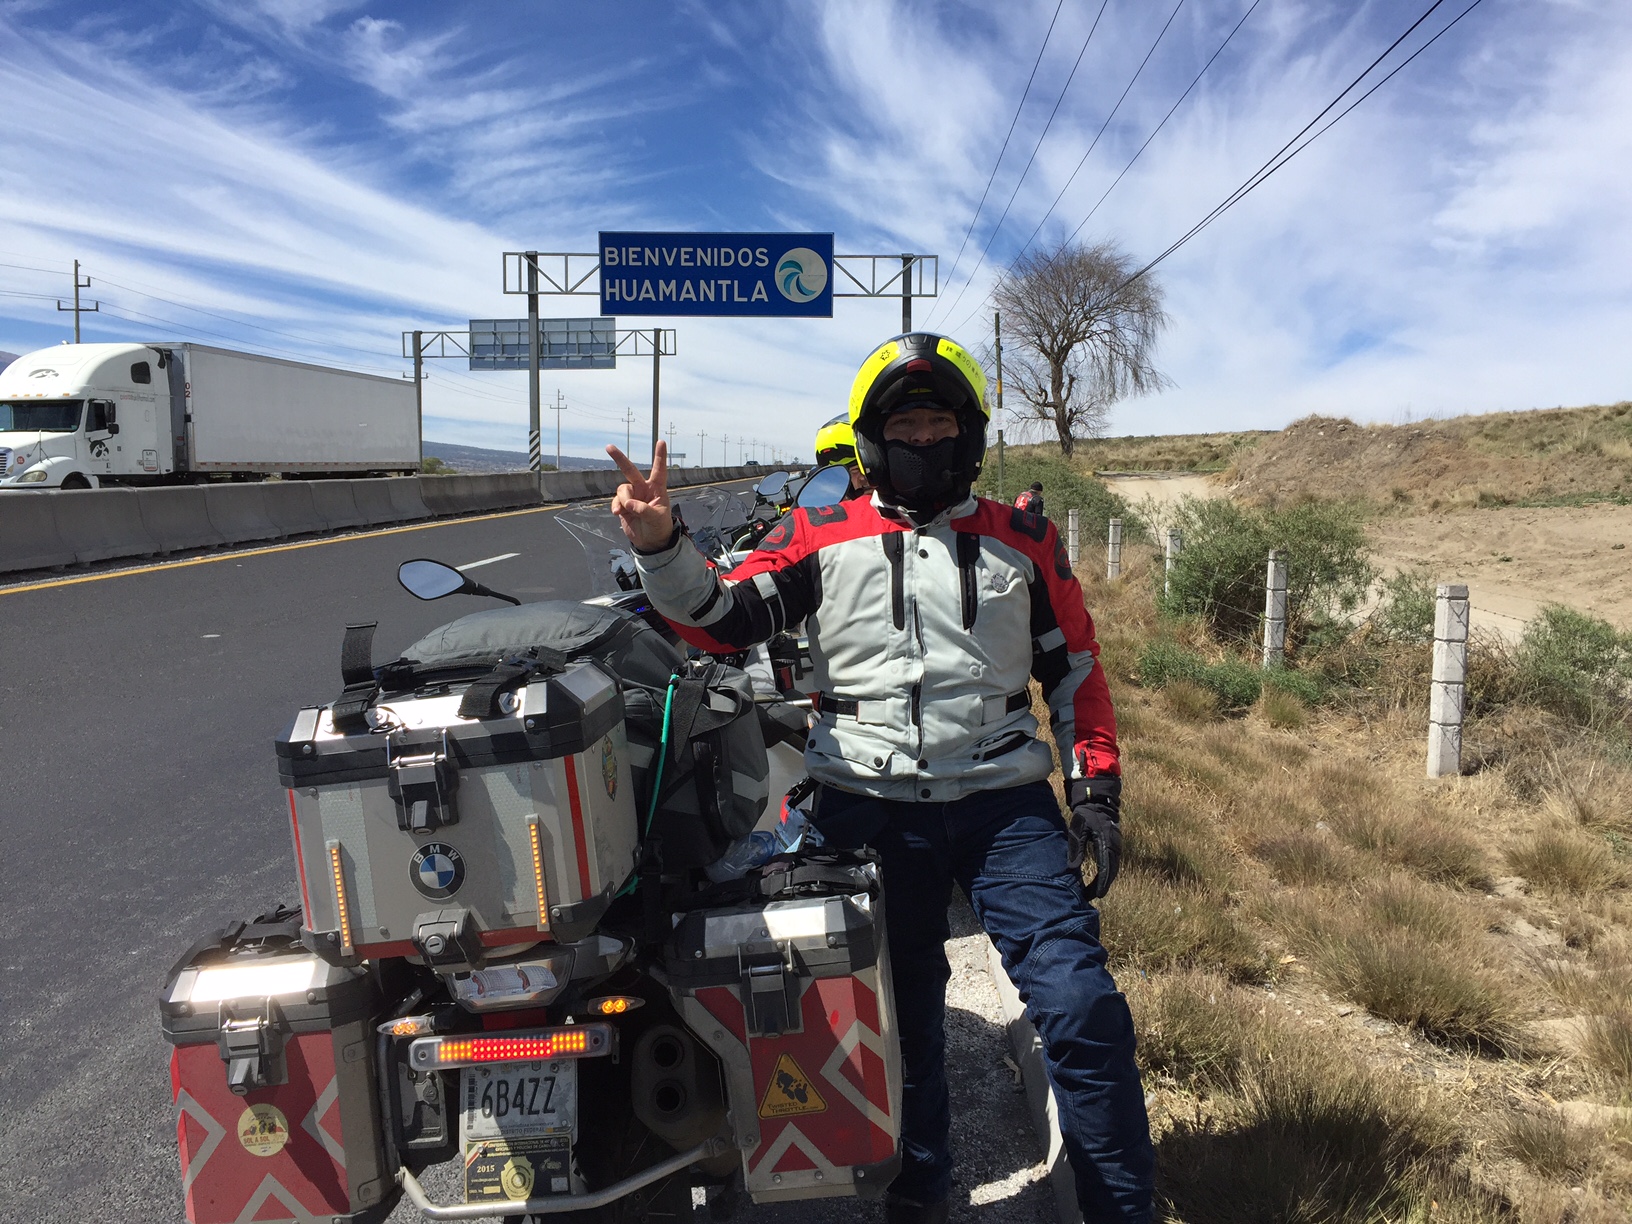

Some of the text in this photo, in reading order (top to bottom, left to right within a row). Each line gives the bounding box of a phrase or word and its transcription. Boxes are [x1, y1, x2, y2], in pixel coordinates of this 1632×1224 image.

[604, 246, 770, 267] BIENVENIDOS
[605, 279, 769, 303] HUAMANTLA
[413, 844, 460, 864] BMW
[480, 1076, 556, 1119] 6B4ZZ
[767, 1101, 798, 1109] TWISTED
[476, 1164, 495, 1173] 2015
